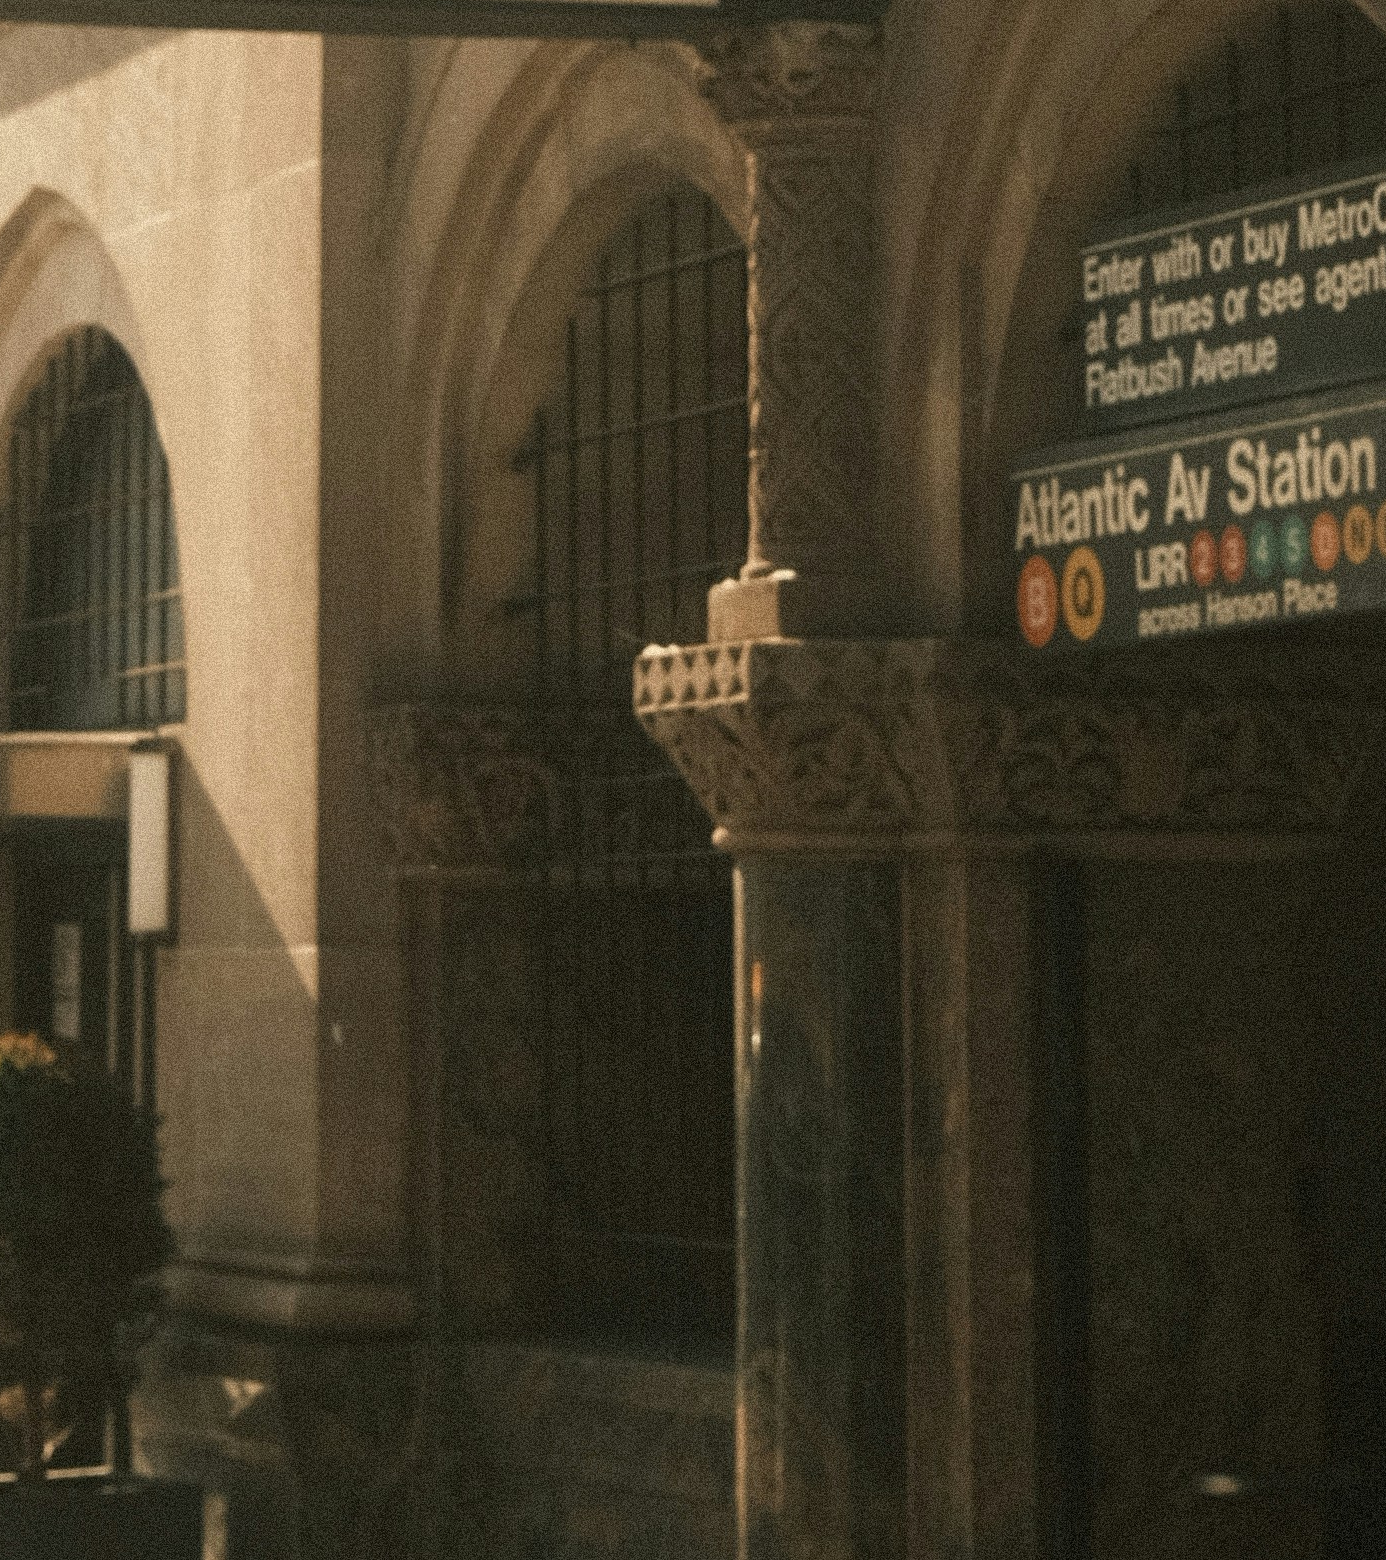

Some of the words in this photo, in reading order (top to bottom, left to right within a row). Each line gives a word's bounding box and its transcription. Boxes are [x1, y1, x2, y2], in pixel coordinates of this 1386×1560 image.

[1083, 254, 1144, 301] Enter
[1152, 231, 1201, 284] with
[1209, 234, 1235, 273] or
[1243, 219, 1289, 267] buy
[1085, 310, 1108, 355] at
[1116, 299, 1142, 348] all
[1150, 293, 1214, 340] times
[1223, 284, 1249, 324] or
[1258, 273, 1305, 318] see
[1085, 346, 1183, 407] Flatbush
[1192, 335, 1279, 387] Avenue
[1015, 464, 1150, 551] Atlantic
[1165, 452, 1211, 526] Av
[1227, 426, 1378, 515] Station
[1026, 578, 1048, 630] B
[1072, 566, 1094, 621] Q
[1134, 540, 1188, 591] LIRR
[1138, 601, 1200, 638] across
[1206, 589, 1278, 626] Hanson
[1283, 577, 1338, 617] Place
